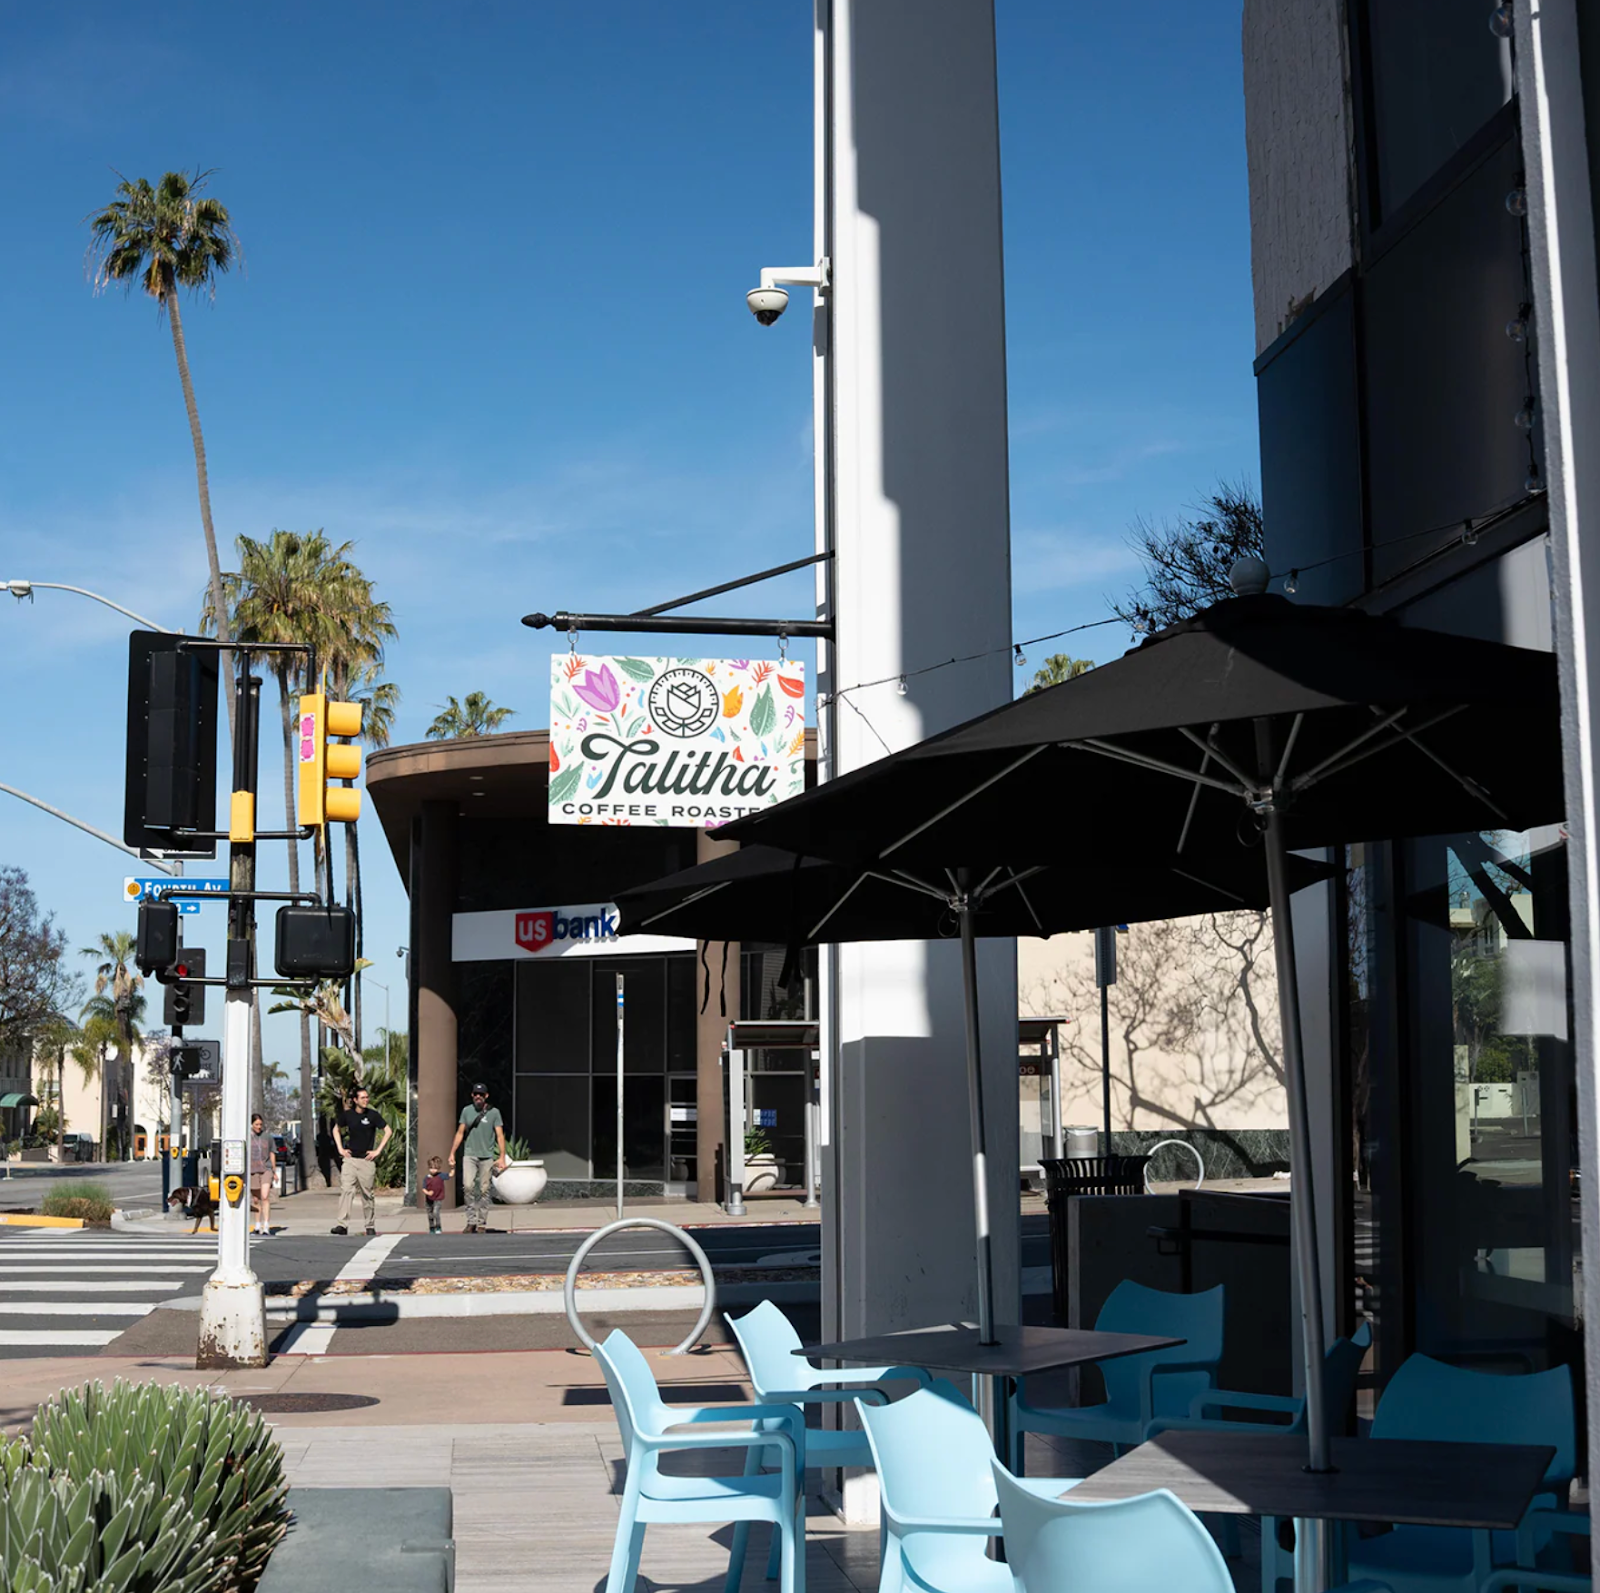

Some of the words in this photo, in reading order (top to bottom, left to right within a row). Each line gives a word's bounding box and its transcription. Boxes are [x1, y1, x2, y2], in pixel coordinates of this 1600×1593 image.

[580, 733, 777, 799] Talitha
[562, 803, 657, 816] COFFEE
[672, 806, 761, 818] ROASTE
